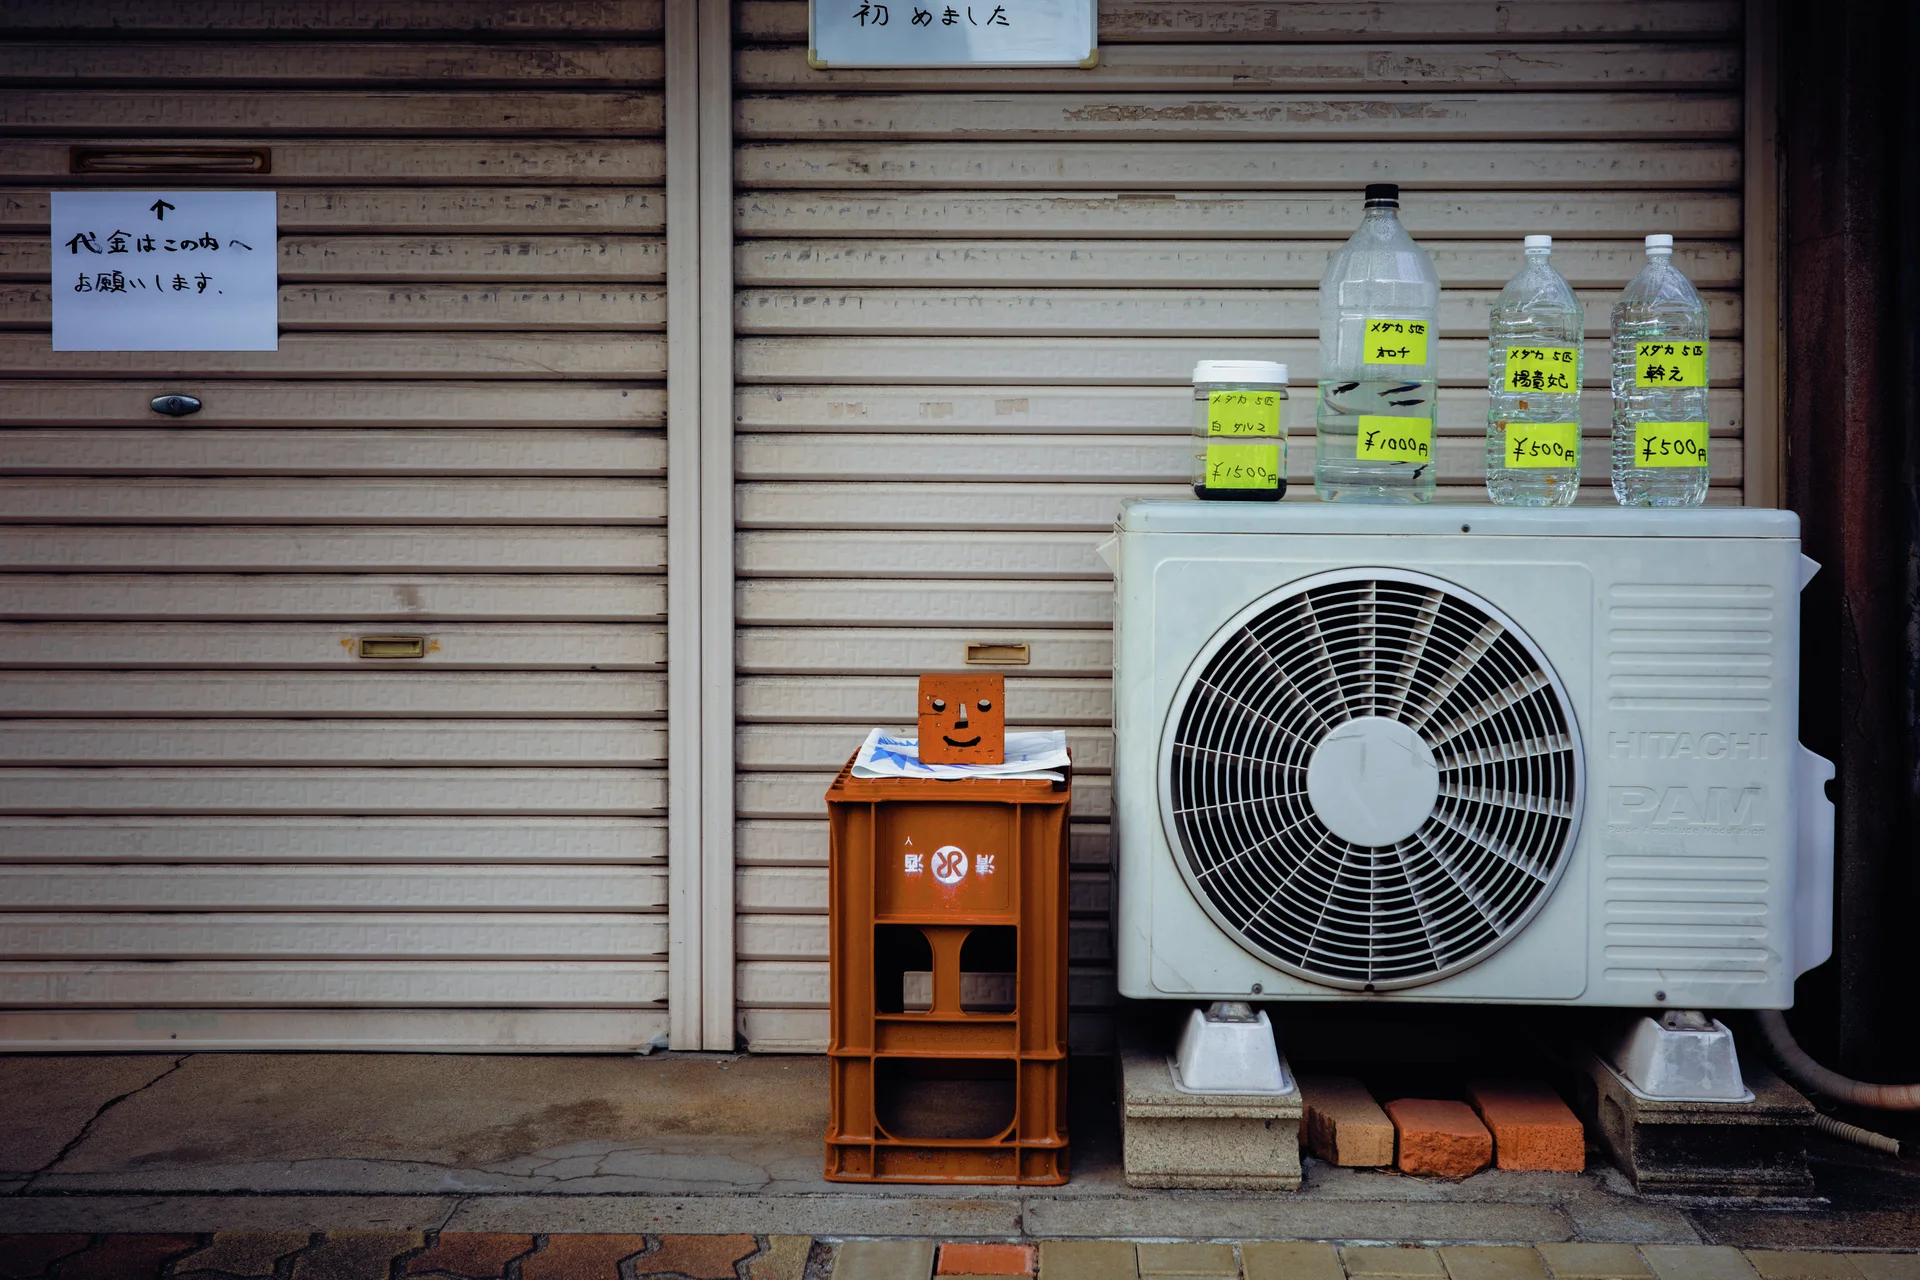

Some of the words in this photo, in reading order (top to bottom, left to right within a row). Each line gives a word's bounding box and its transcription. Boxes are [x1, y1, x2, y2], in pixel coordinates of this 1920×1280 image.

[65, 229, 253, 254] 代金はこの内へ
[1370, 322, 1404, 334] メダカ
[1408, 323, 1425, 335] 5匹
[1510, 349, 1544, 360] メダカ
[1552, 351, 1573, 363] 5匹
[1639, 343, 1675, 357] メダカ
[1681, 344, 1704, 357] 5匹
[1511, 370, 1569, 390] 楊貴妃
[1213, 395, 1248, 405] メダカ
[1255, 395, 1274, 406] 5匹
[1513, 437, 1575, 462] ¥500円
[1642, 436, 1707, 462] ¥500円
[1607, 731, 1769, 760] HITACHI
[1607, 785, 1766, 826] PAM
[1607, 825, 1640, 836] Pulse
[1643, 825, 1700, 836] Amplitude
[1703, 826, 1766, 837] Modulation
